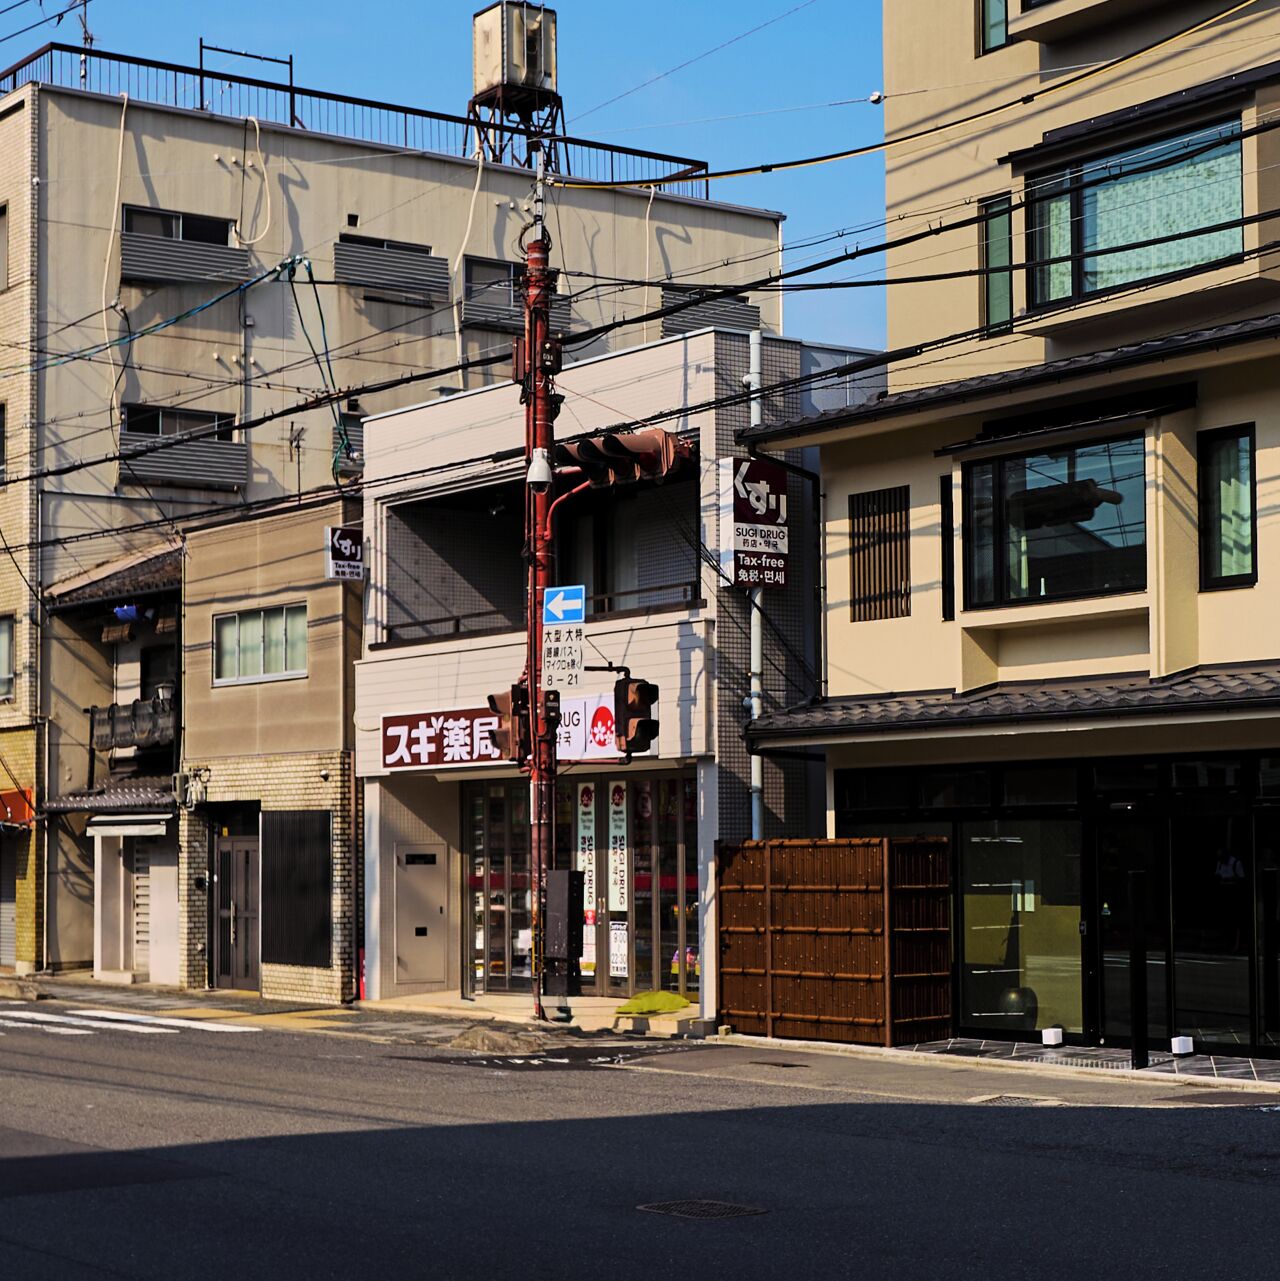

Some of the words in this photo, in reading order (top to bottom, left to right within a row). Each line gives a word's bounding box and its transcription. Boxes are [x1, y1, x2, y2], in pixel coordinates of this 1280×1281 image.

[734, 461, 787, 524] くすり
[332, 530, 362, 560] くすり
[736, 527, 758, 538] SUGI
[759, 529, 786, 540] DRUG
[737, 553, 785, 568] Tax-free
[385, 715, 501, 765] スギ薬局
